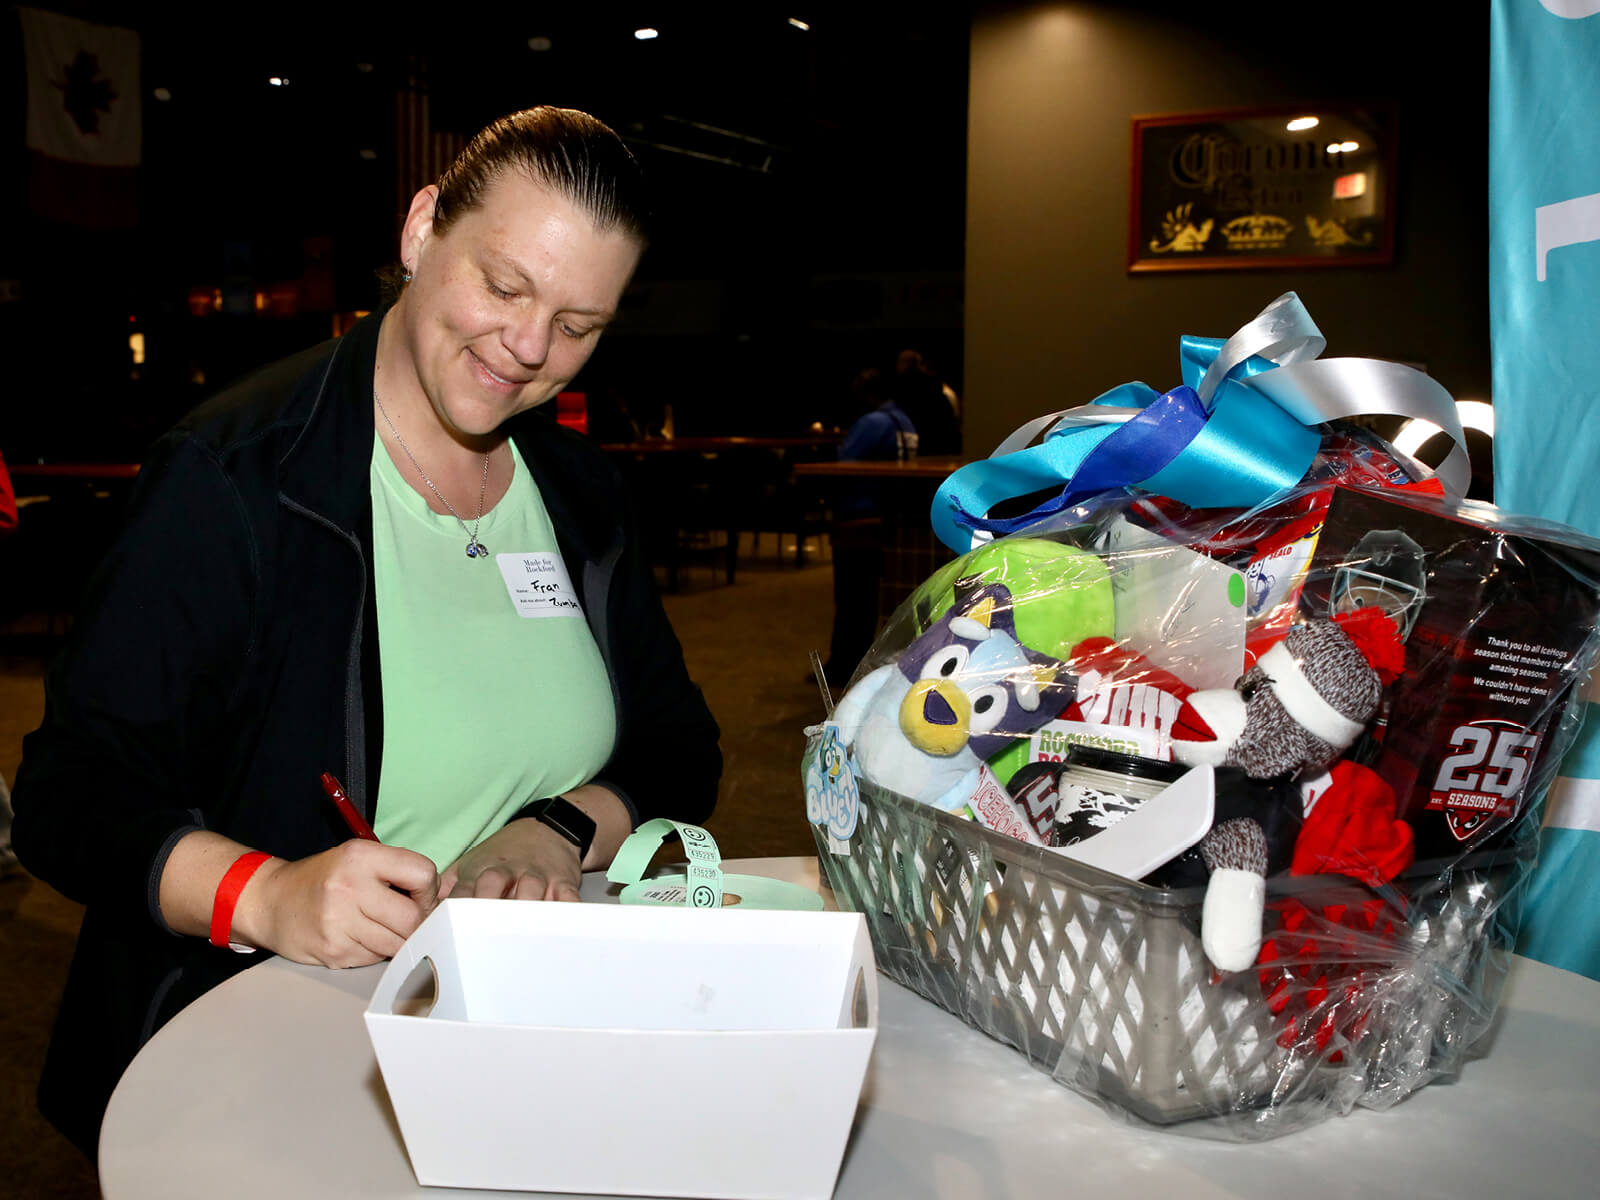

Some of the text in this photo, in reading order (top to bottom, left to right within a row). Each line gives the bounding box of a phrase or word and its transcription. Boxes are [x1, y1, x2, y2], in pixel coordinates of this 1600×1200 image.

[525, 565, 556, 573] Rockford
[530, 579, 560, 593] Fran
[1487, 636, 1568, 659] Thank you to all IceHogs
[1473, 648, 1562, 670] season ticket members for
[1488, 663, 1549, 680] amazing seasons.
[1473, 676, 1485, 686] We
[1485, 679, 1513, 691] couldn't
[1513, 683, 1530, 694] have
[1530, 686, 1548, 696] done
[1488, 692, 1531, 706] without you!
[1433, 724, 1538, 799] 25
[1447, 793, 1497, 809] SEASONS
[807, 785, 857, 838] BLUEY
